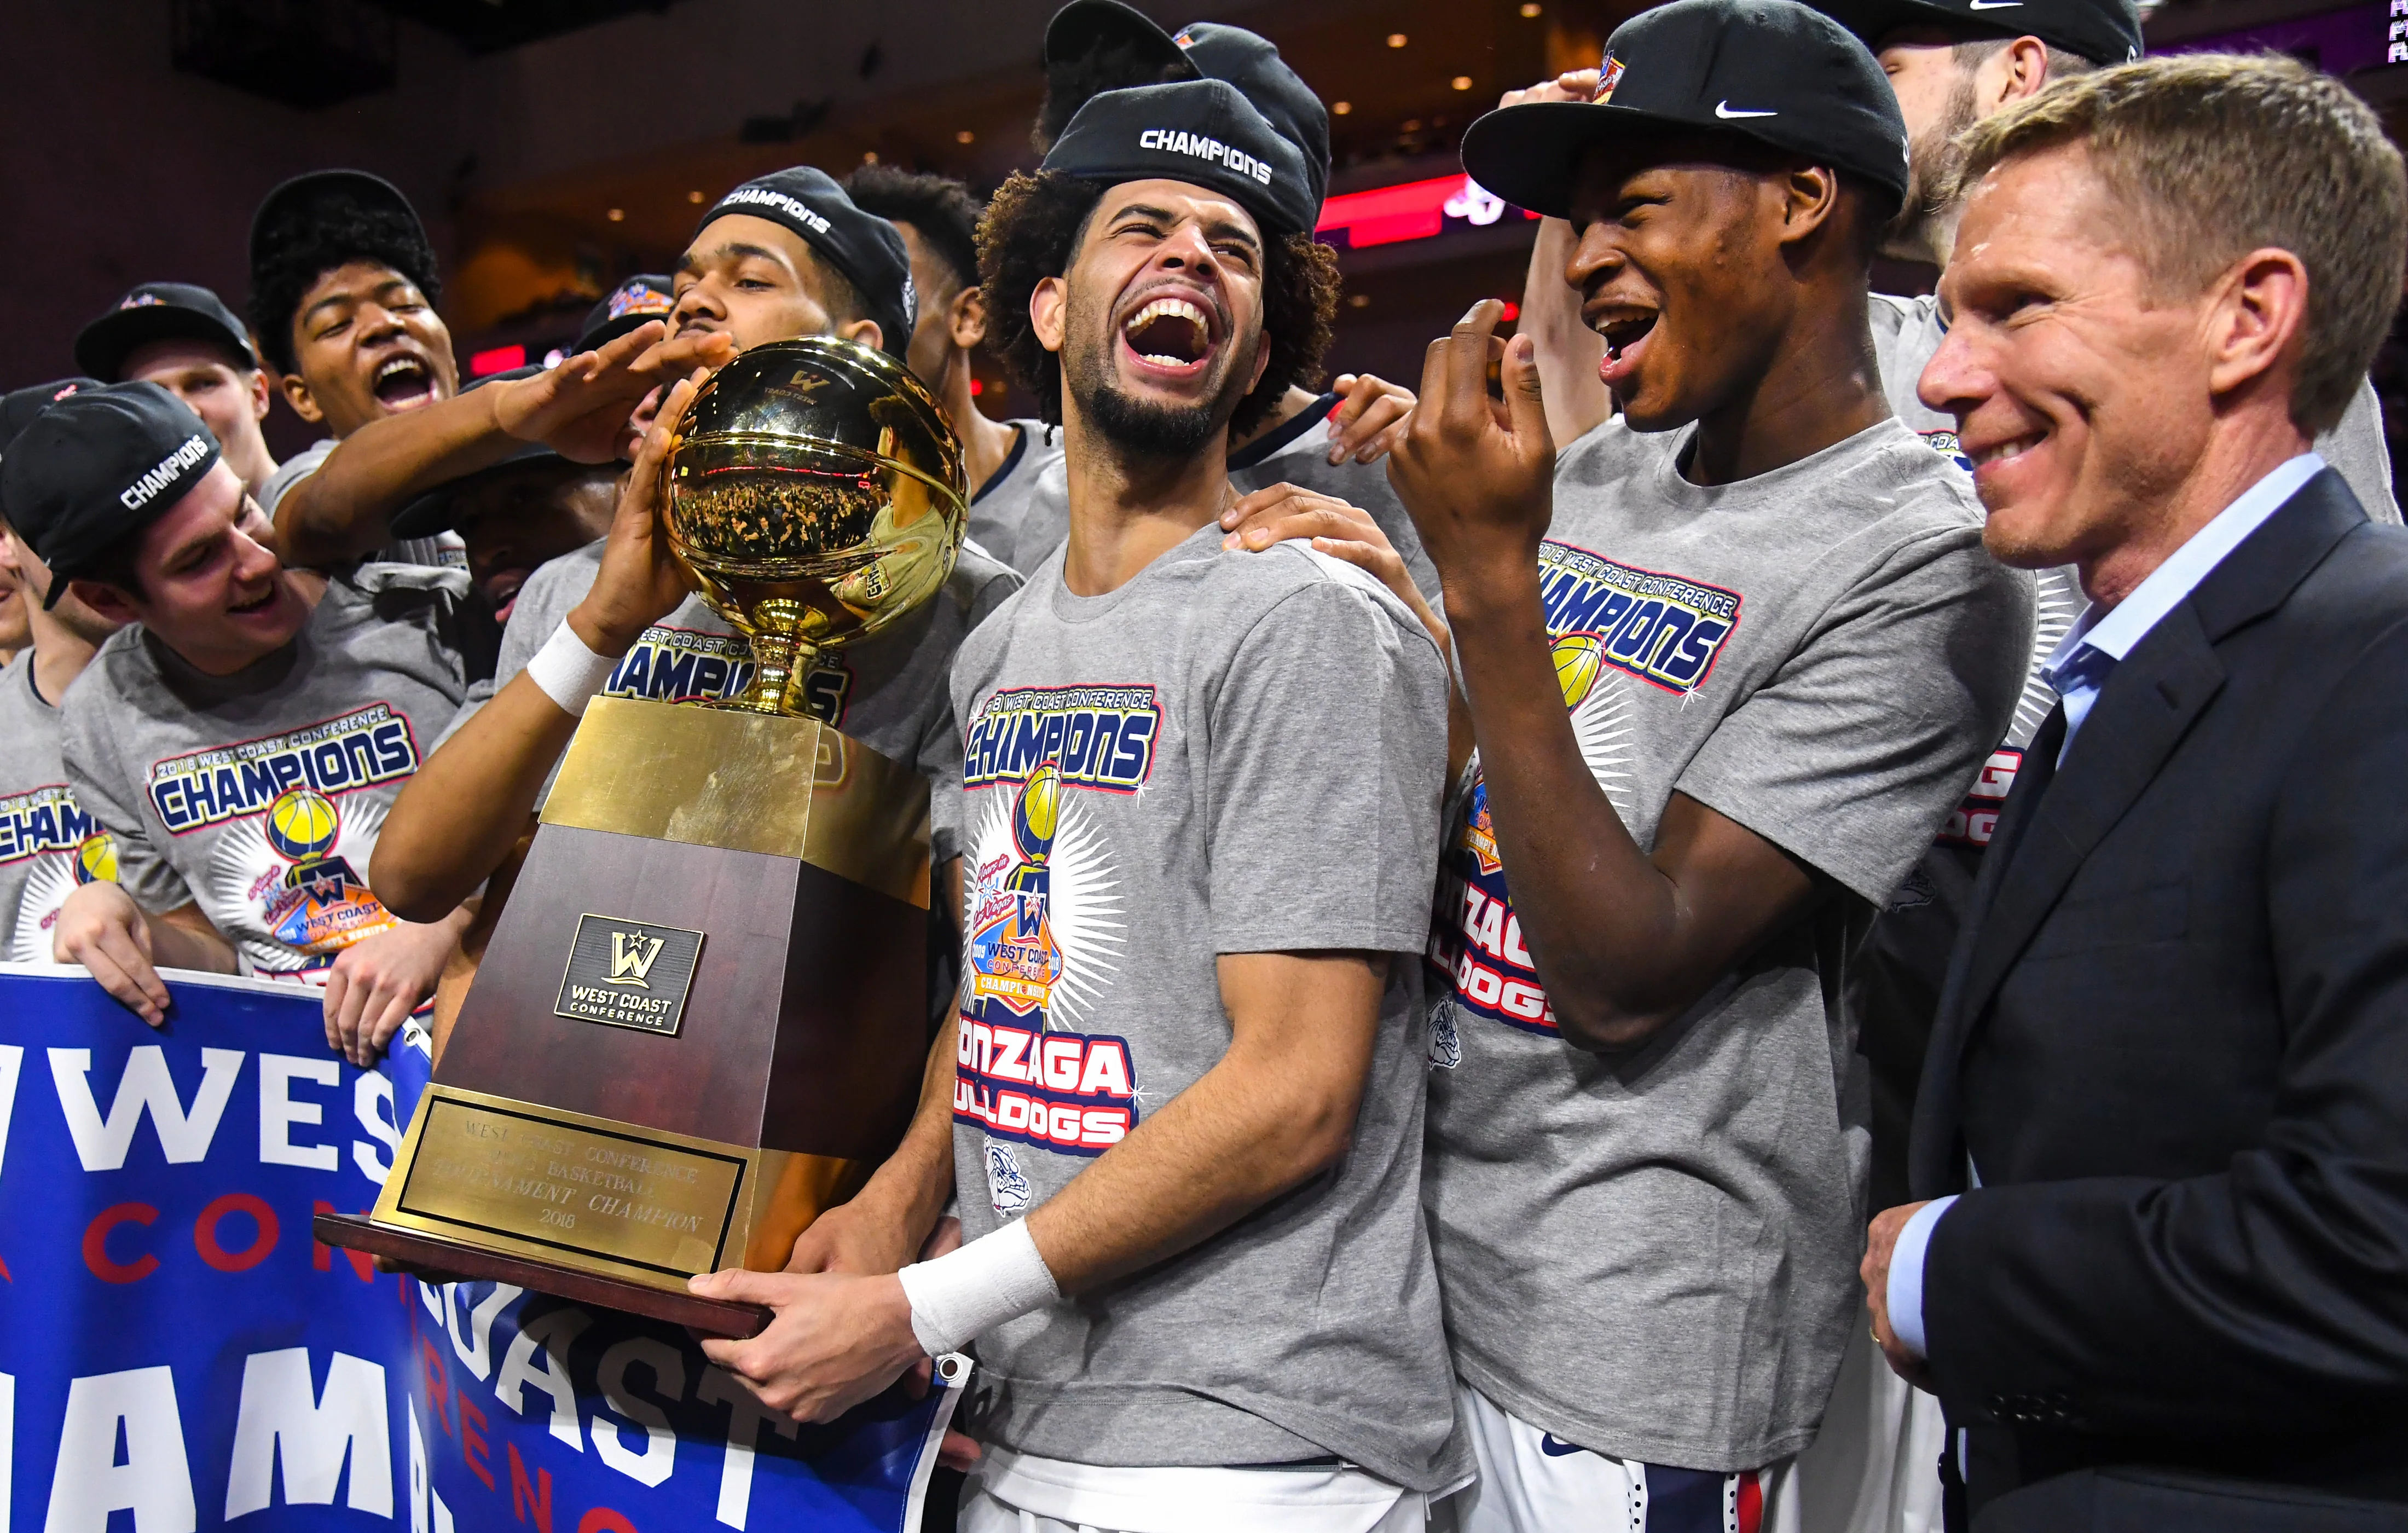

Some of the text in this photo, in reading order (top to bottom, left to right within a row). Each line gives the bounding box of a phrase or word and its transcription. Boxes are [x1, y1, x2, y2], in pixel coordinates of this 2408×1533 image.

[1139, 130, 1272, 185] CHAMPIONS
[722, 189, 831, 234] CHAMPIONS
[1930, 436, 1959, 450] COA
[120, 434, 209, 510] CHAMPIONS
[1538, 545, 1733, 618] 018 WEST COAST CONFERENCE
[640, 629, 669, 643] EST
[673, 634, 723, 652] COAST
[1006, 695, 1032, 710] WEST
[1033, 695, 1066, 710] COAST
[1067, 691, 1151, 710] CONFERENCE
[158, 708, 388, 777] 2018 WEST COAST CONFERENCE
[155, 720, 410, 830] CHAMPIONS
[296, 901, 378, 932] WEST COAST
[985, 896, 1014, 918] Vegas
[611, 932, 665, 979] W
[973, 944, 986, 958] 2009
[987, 942, 1026, 961] WEST
[987, 959, 1045, 978] CONFEREE
[1048, 956, 1060, 971] 2018
[570, 1002, 664, 1026] CONFERENCE
[572, 985, 673, 1014] WEST COAST
[959, 1017, 1128, 1095] ONZAGA
[47, 1045, 403, 1185] WES
[954, 1079, 1127, 1143] ULLDOGS
[466, 1120, 508, 1141] WEST
[586, 1147, 699, 1184] CONFERENCE
[539, 1208, 576, 1229] 2018
[589, 1194, 703, 1233] CHAMPION
[419, 1280, 797, 1531] OAST
